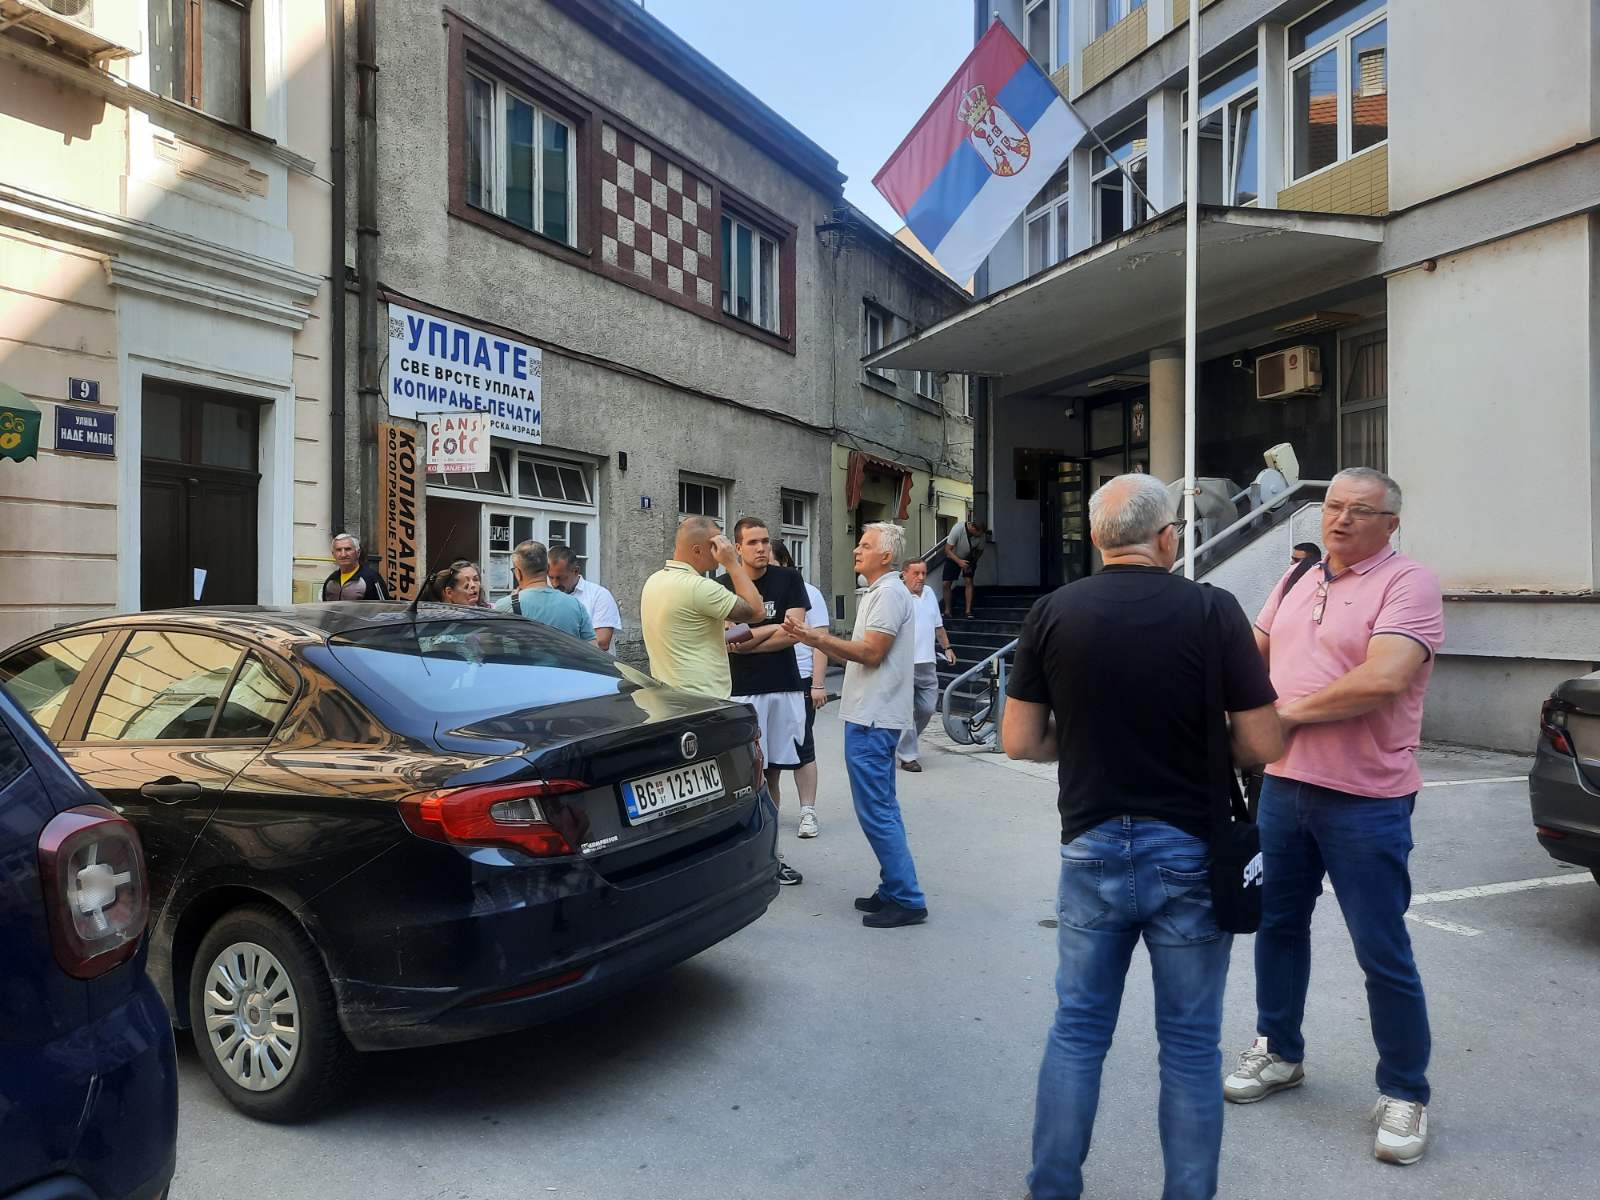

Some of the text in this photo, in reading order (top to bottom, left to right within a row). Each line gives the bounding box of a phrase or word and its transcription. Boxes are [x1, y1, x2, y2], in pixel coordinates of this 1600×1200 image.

[407, 314, 527, 381] УПЛАТЕ
[80, 381, 90, 398] 9
[400, 357, 535, 402] СВЕ ВРСТЕ УПЛАТА
[75, 415, 98, 427] УЛИЦА
[490, 420, 541, 437] РСКА ИЗРАДА
[60, 428, 84, 441] НАДЕ
[399, 429, 416, 601] КОПИРАЊ
[634, 780, 657, 810] BG
